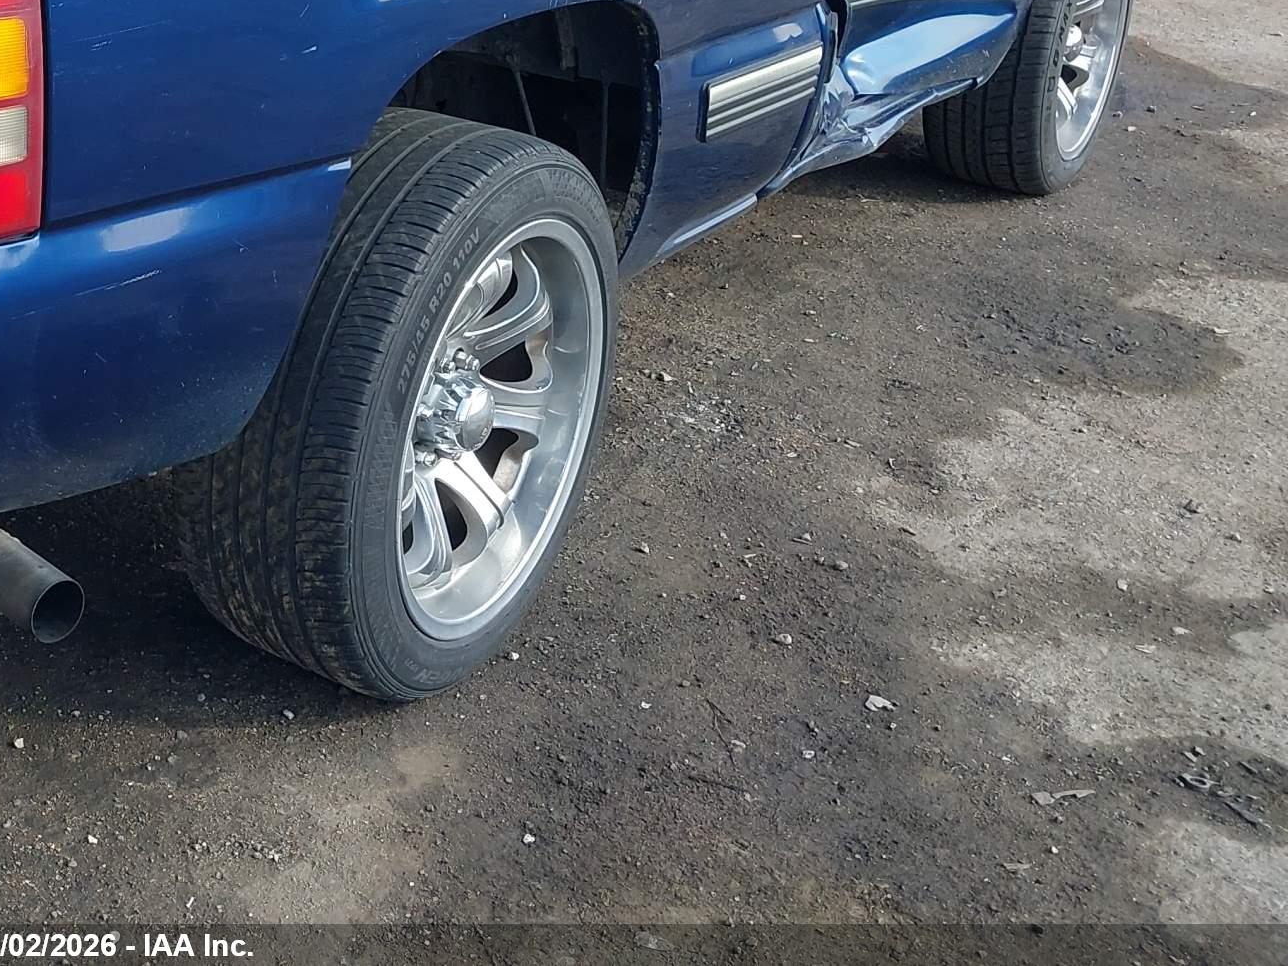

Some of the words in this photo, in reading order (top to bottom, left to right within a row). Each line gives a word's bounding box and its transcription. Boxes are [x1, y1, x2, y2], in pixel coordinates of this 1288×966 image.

[398, 315, 431, 395] 275/45
[428, 272, 452, 314] R20
[453, 226, 480, 270] 110V
